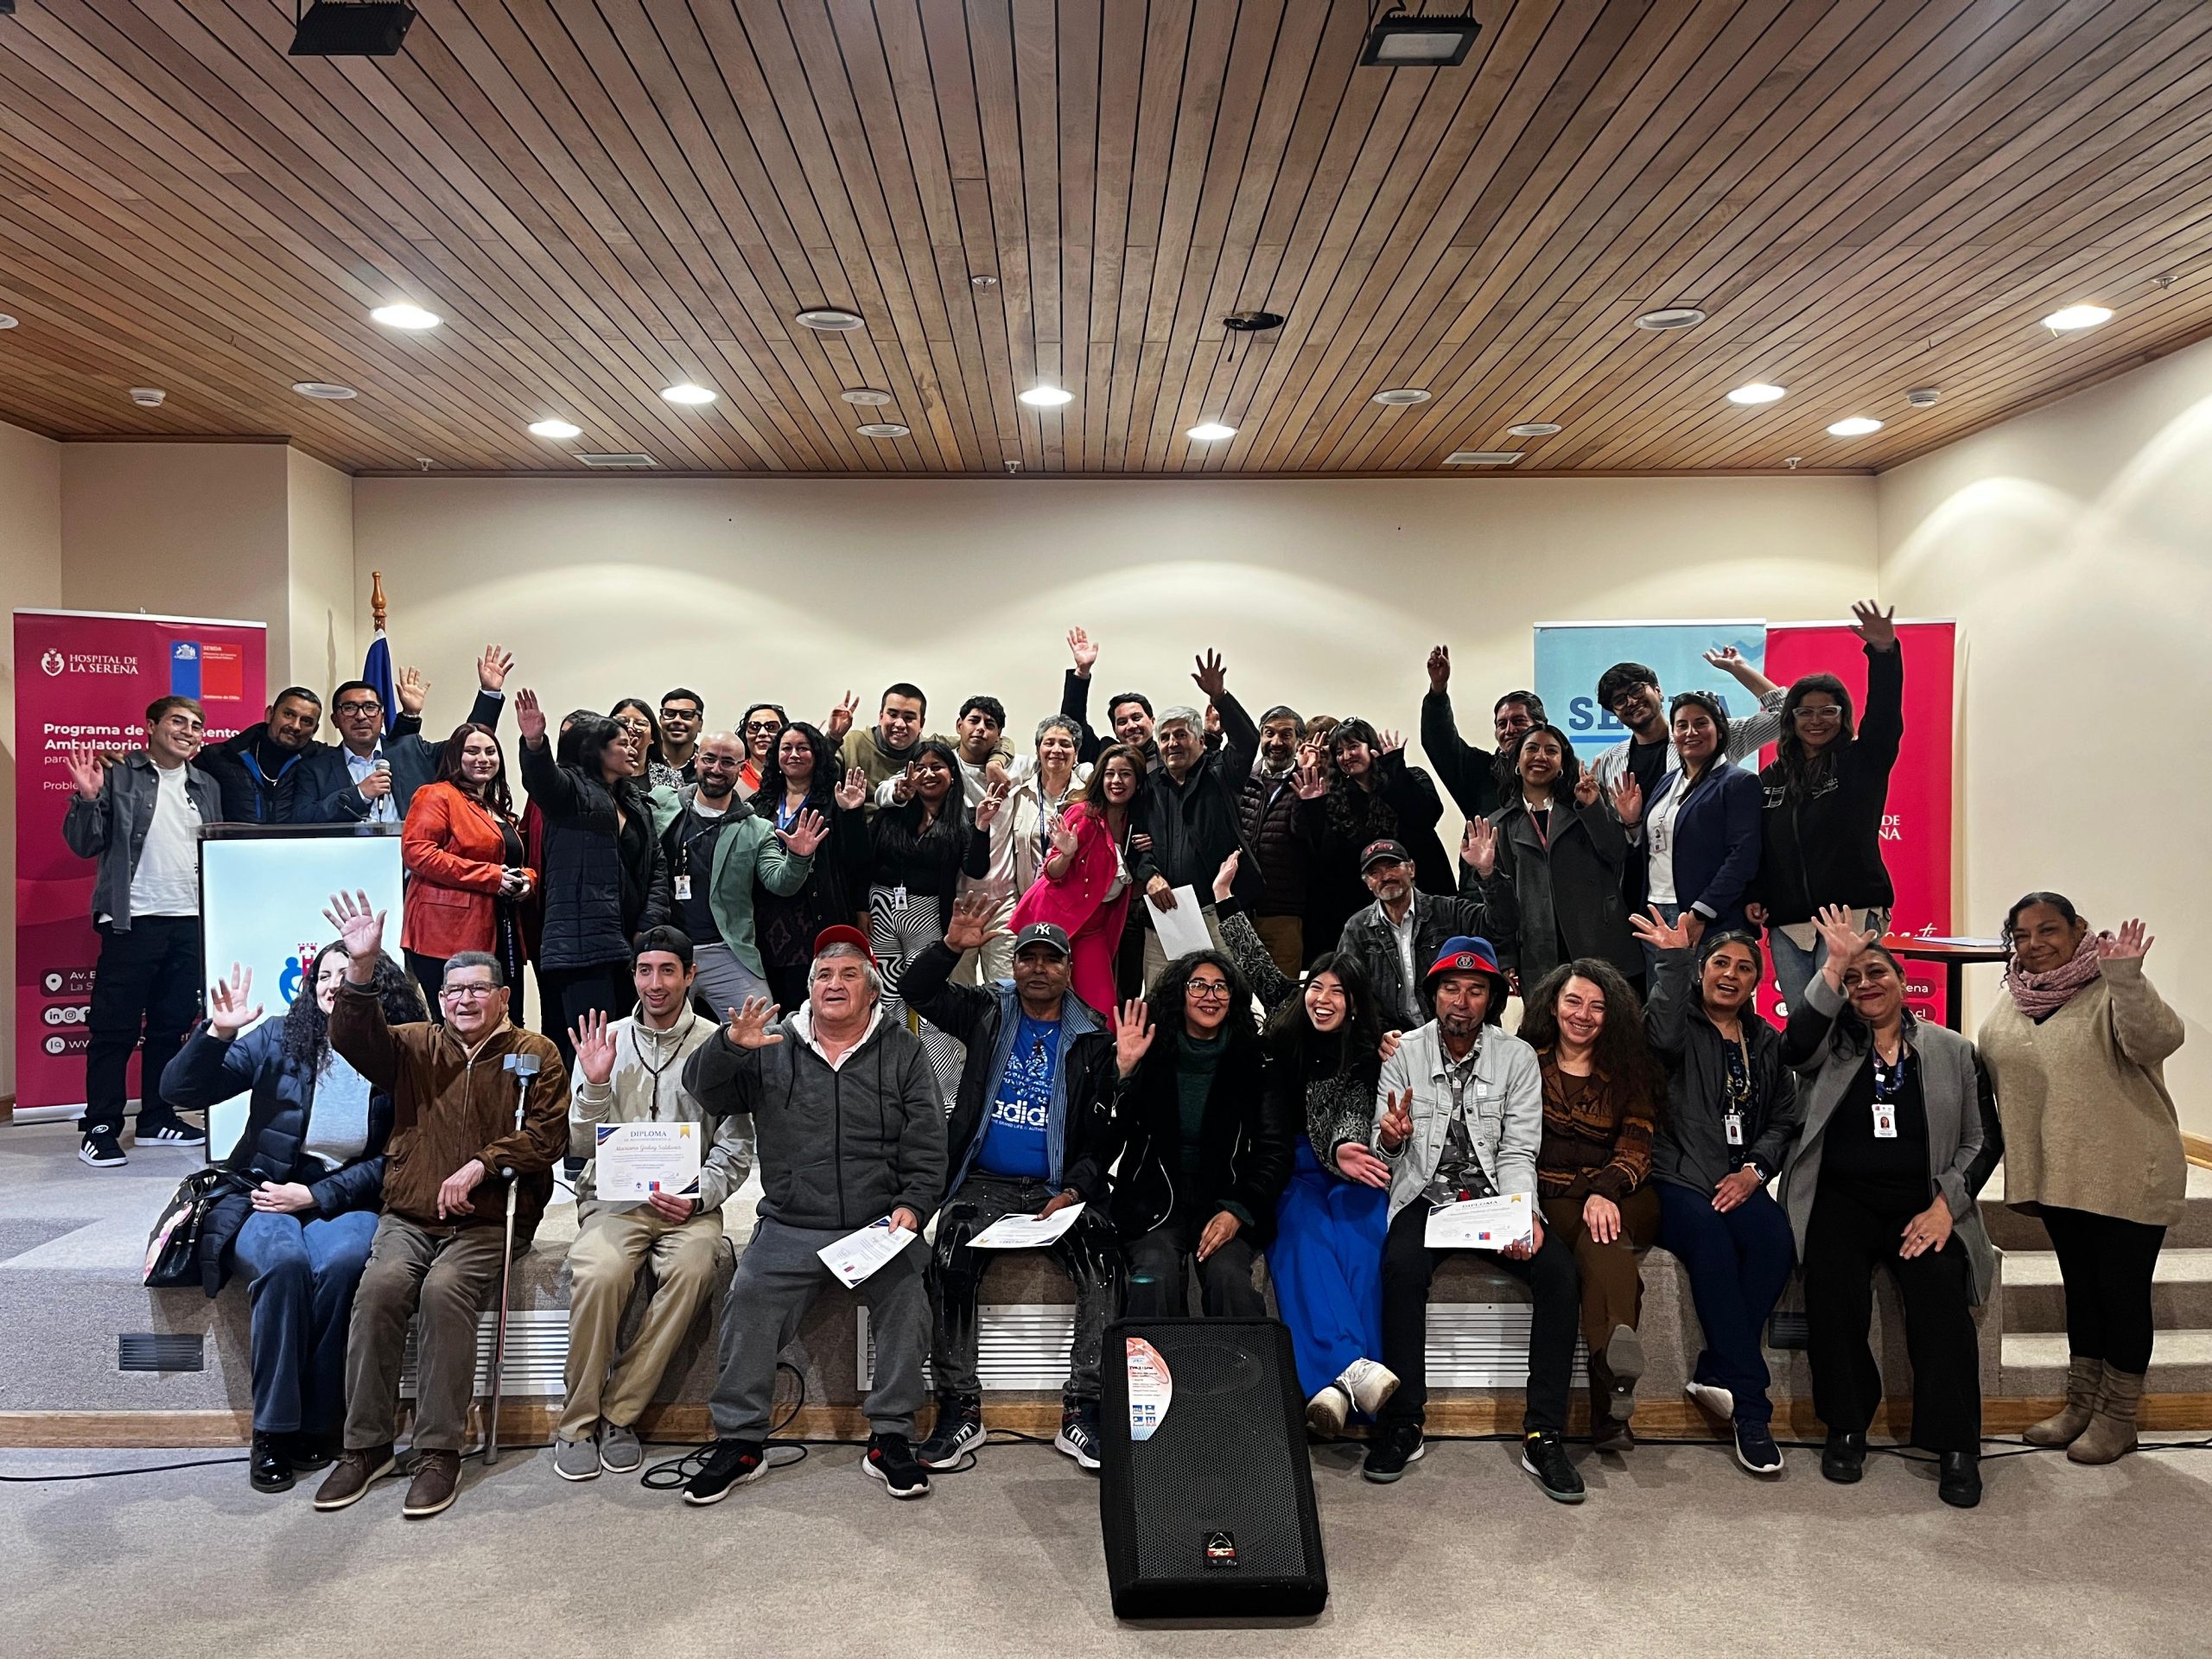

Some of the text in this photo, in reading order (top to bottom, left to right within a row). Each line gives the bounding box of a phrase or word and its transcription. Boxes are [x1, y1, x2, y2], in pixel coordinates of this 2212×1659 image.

[69, 654, 138, 664] HOSPITAL DE
[70, 663, 138, 674] LA SERENA
[44, 723, 241, 738] Programa de ento
[44, 739, 142, 751] Ambulatorio
[1881, 815, 1901, 826] DE
[1878, 827, 1903, 840] NA
[70, 971, 86, 980] Av.
